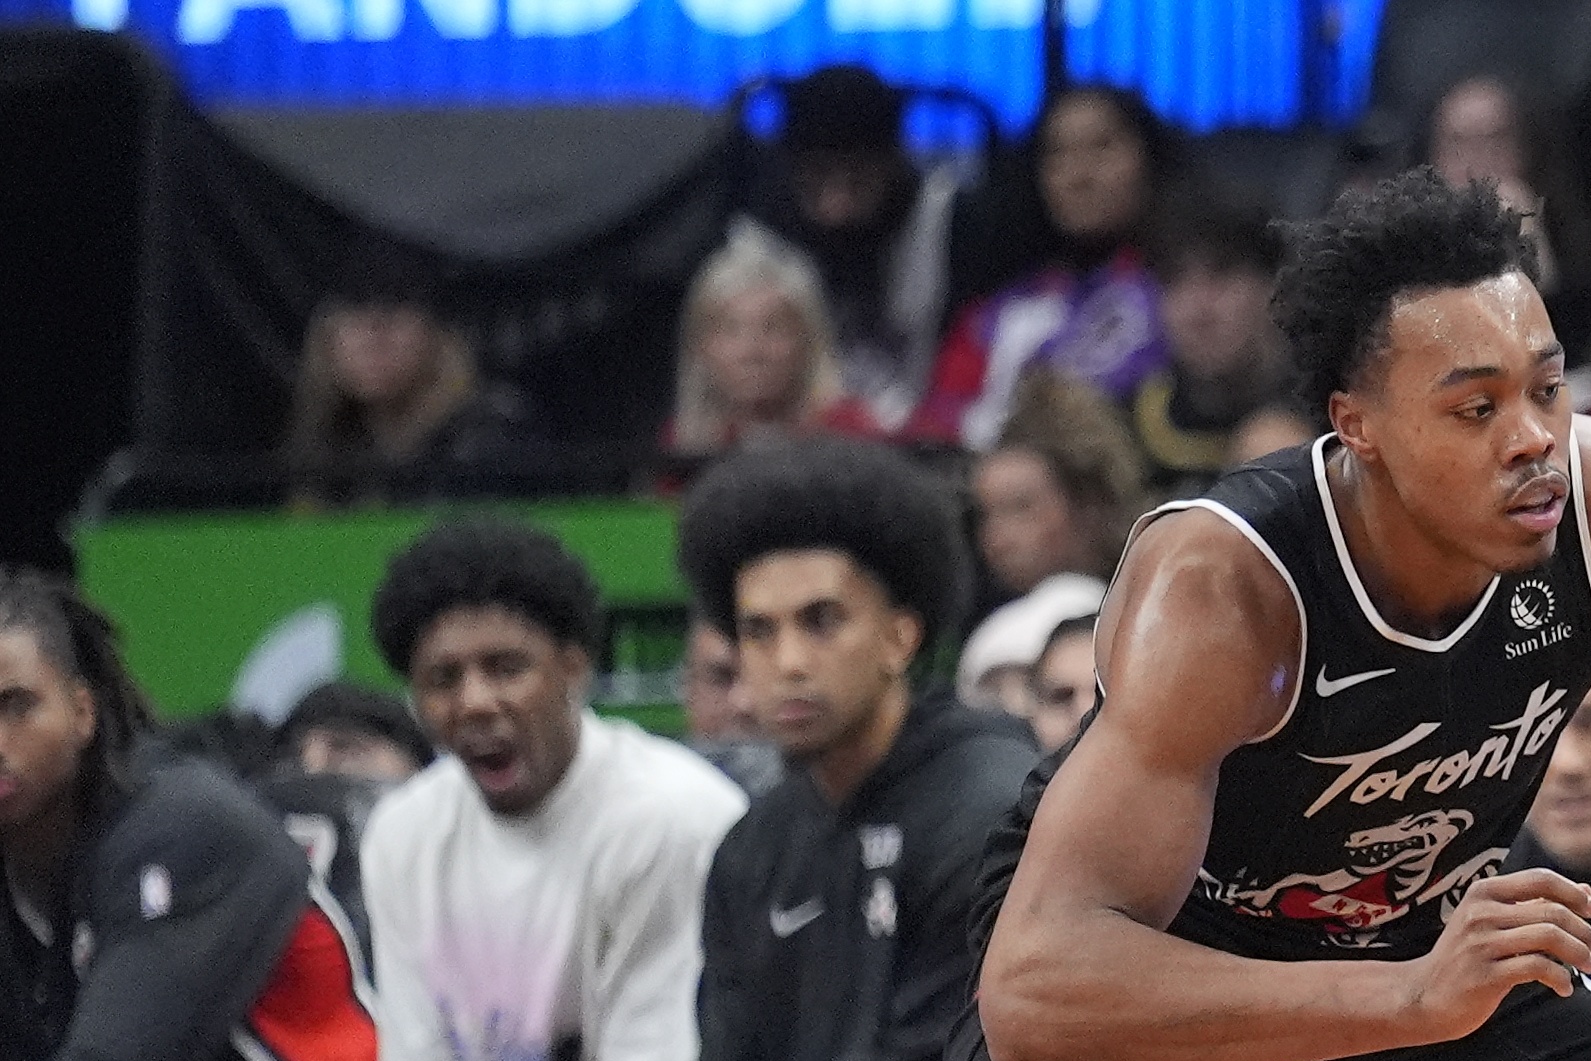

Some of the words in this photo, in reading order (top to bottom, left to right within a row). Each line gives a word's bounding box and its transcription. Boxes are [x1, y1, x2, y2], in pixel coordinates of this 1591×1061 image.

[1504, 638, 1539, 660] Sun
[1540, 621, 1573, 647] Life
[1297, 680, 1567, 819] Toronto
